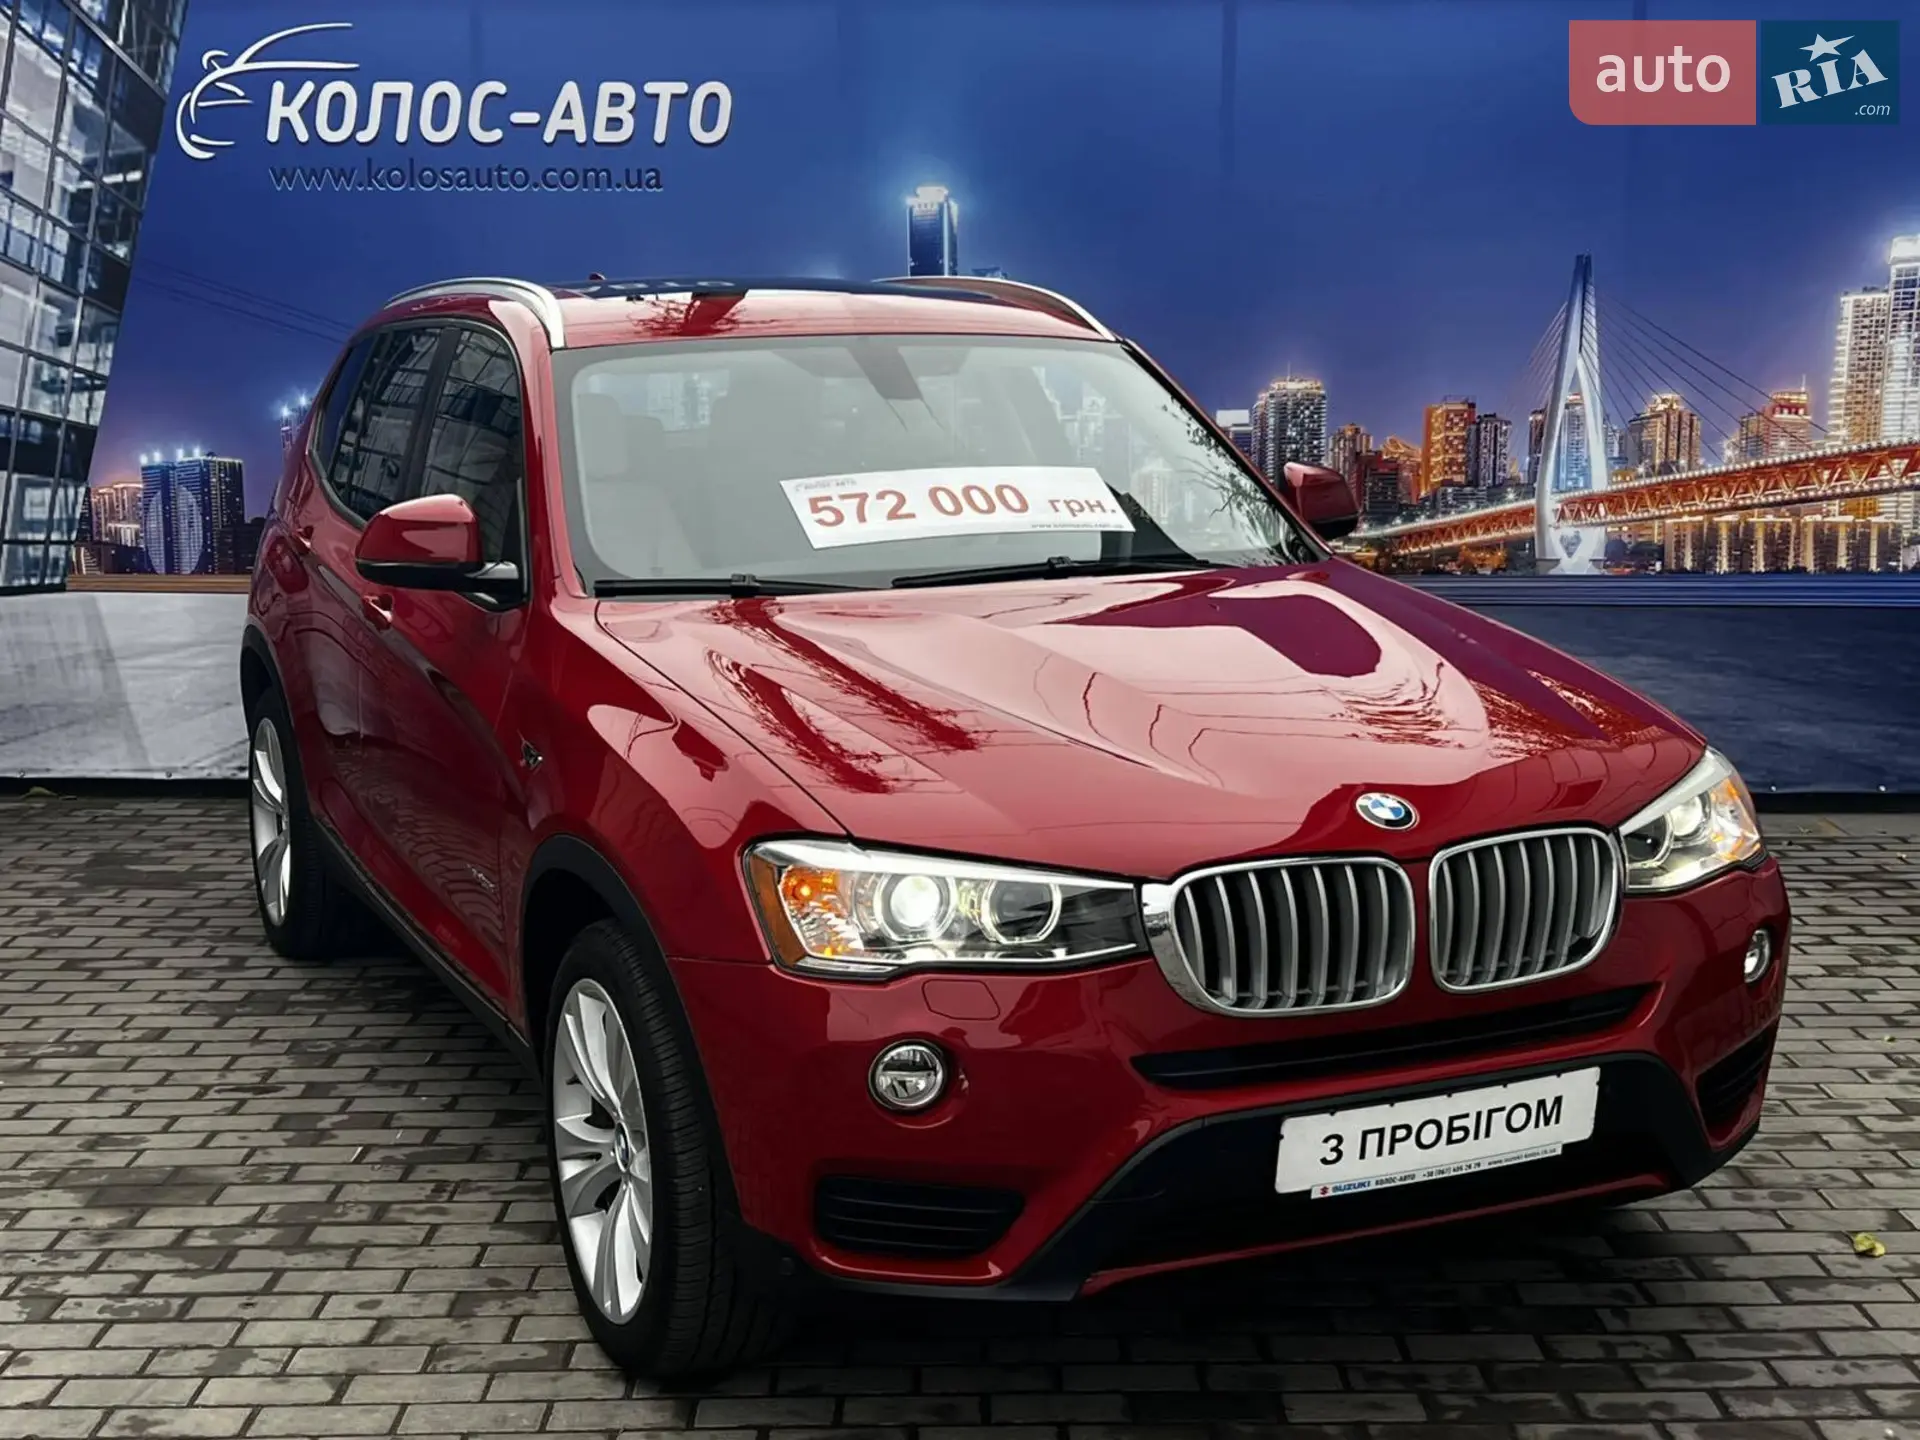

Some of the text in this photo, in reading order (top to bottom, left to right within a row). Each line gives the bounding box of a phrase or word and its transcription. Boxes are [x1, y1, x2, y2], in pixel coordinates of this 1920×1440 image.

[265, 80, 733, 145] КОЛОС-АВТО
[268, 157, 664, 193] www.kolosauto.com.ua
[808, 483, 1117, 528] 572 000 грн.
[1358, 1095, 1563, 1160] ПРОБІГОМ
[1332, 1180, 1371, 1194] SUZUKI
